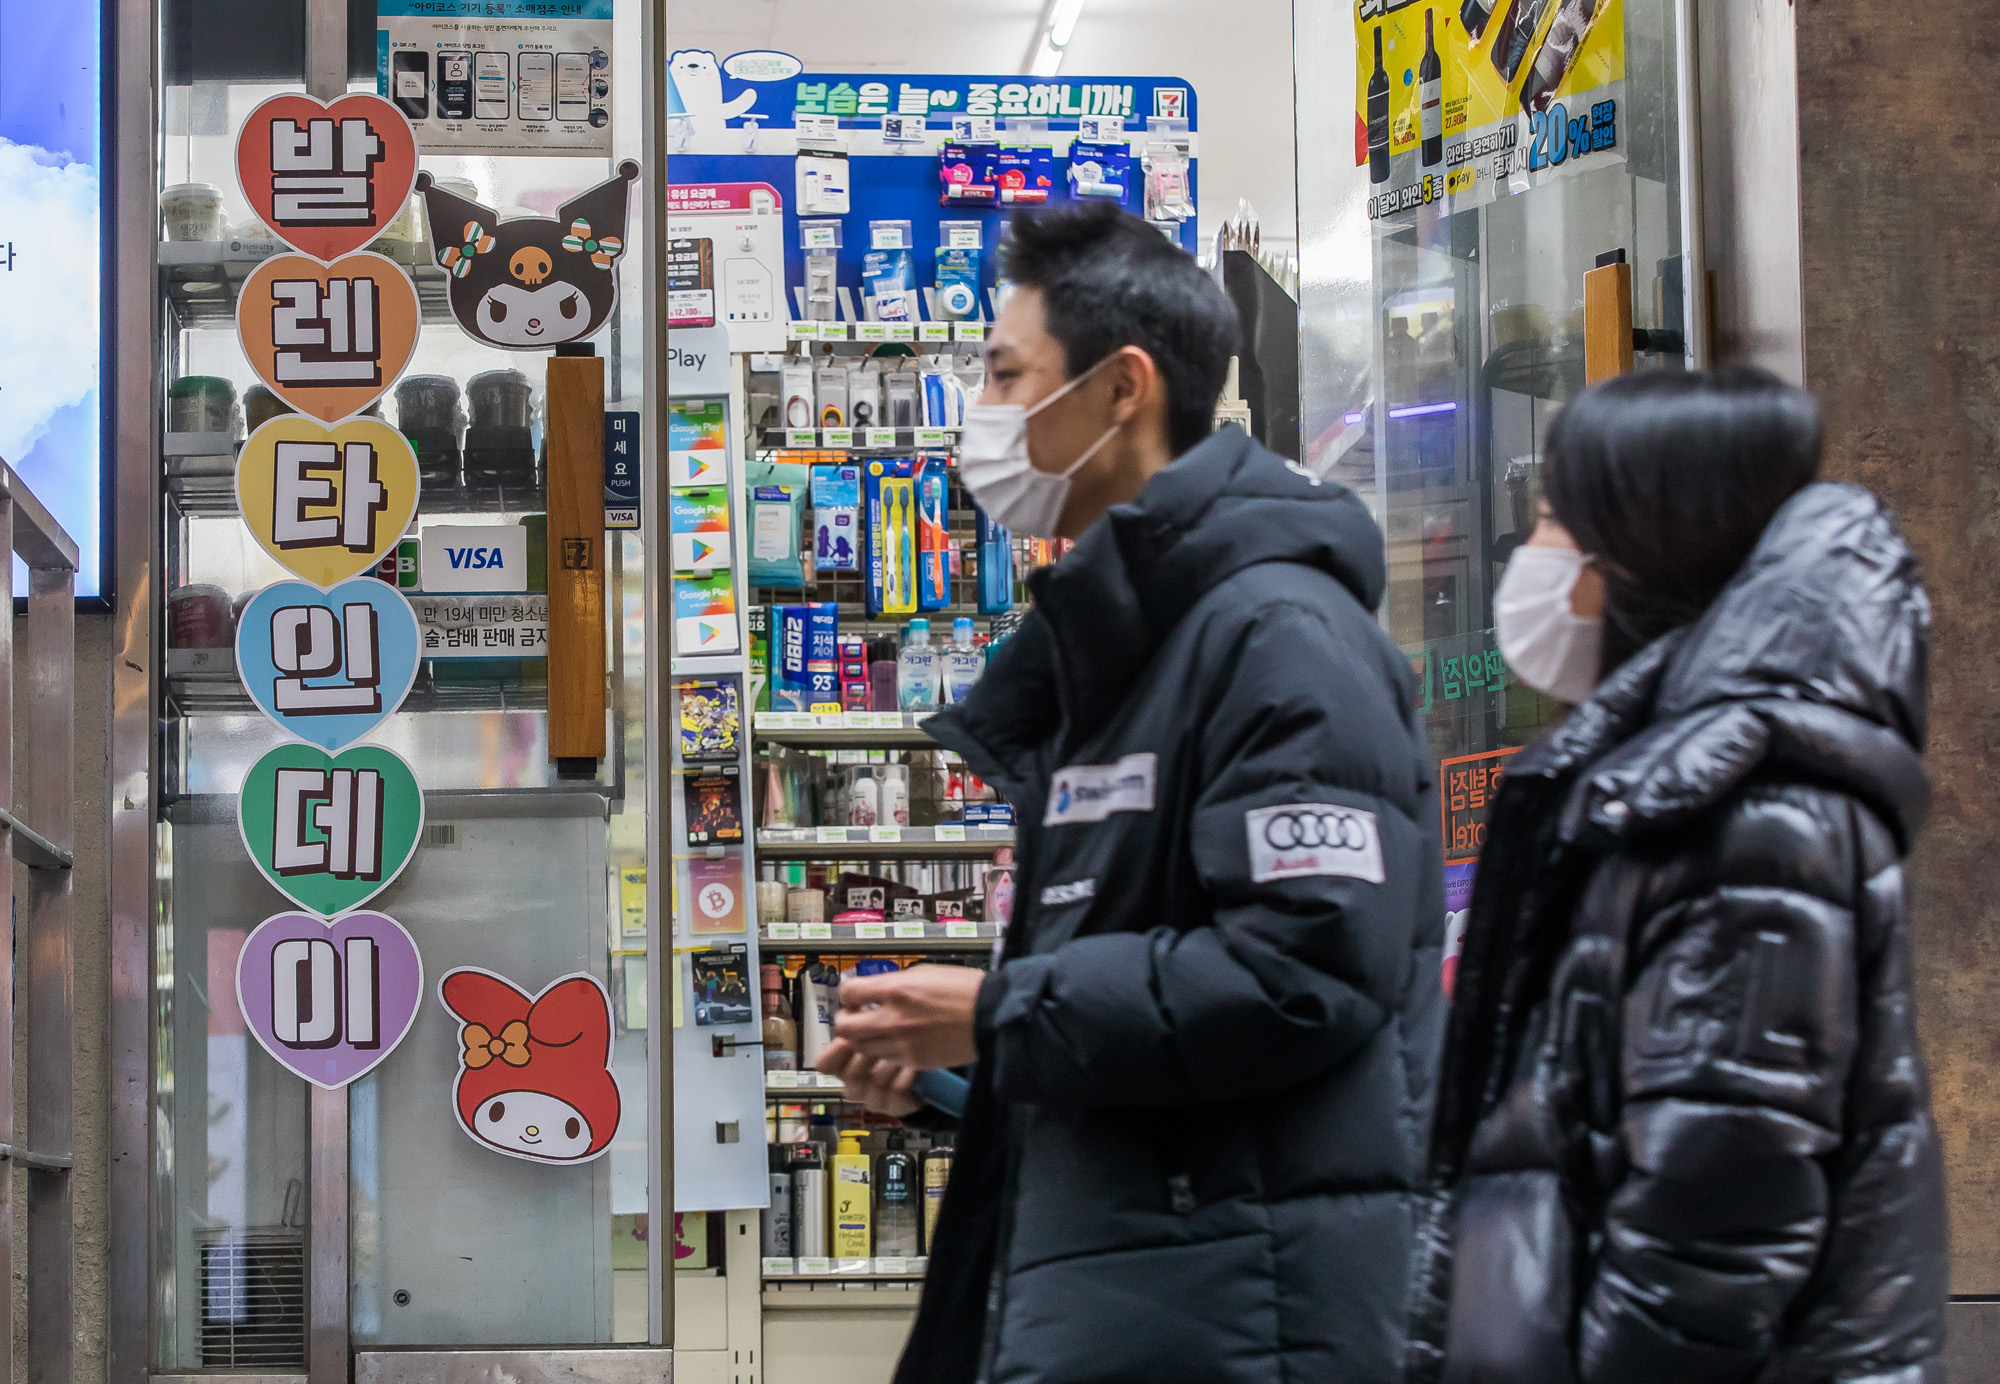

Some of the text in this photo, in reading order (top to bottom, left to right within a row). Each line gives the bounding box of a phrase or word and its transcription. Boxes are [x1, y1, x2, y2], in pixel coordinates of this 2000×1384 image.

[461, 4, 481, 14] 기기
[517, 4, 558, 16] 소매점주
[561, 4, 582, 15] 안내
[795, 82, 891, 117] 보습은
[966, 83, 1135, 117] 중요하니까!
[1591, 99, 1615, 127] 현장
[1446, 123, 1516, 168] 와인은 당연히 711
[1529, 102, 1591, 173] 20%
[1591, 123, 1616, 152] 할인
[1456, 172, 1471, 188] pay
[1476, 165, 1495, 182] 머니
[1493, 152, 1515, 181] 결제
[1366, 196, 1379, 221] 이
[1379, 188, 1402, 219] 달의
[1401, 182, 1423, 212] 와인
[670, 422, 721, 435] Google Play
[613, 418, 628, 475] 미세요
[611, 479, 631, 487] PUSH
[609, 512, 634, 522] VISA
[674, 504, 726, 517] Google Play
[380, 556, 417, 574] CB
[443, 547, 505, 570] VISA
[679, 587, 730, 601] Google Play
[424, 608, 437, 623] 만
[444, 607, 474, 623] 19세
[479, 606, 506, 623] 미만
[482, 628, 515, 647] 판매
[786, 616, 803, 673] 2080
[812, 646, 835, 658] 케어
[904, 655, 932, 667] 가그린
[951, 656, 979, 668] 가그린
